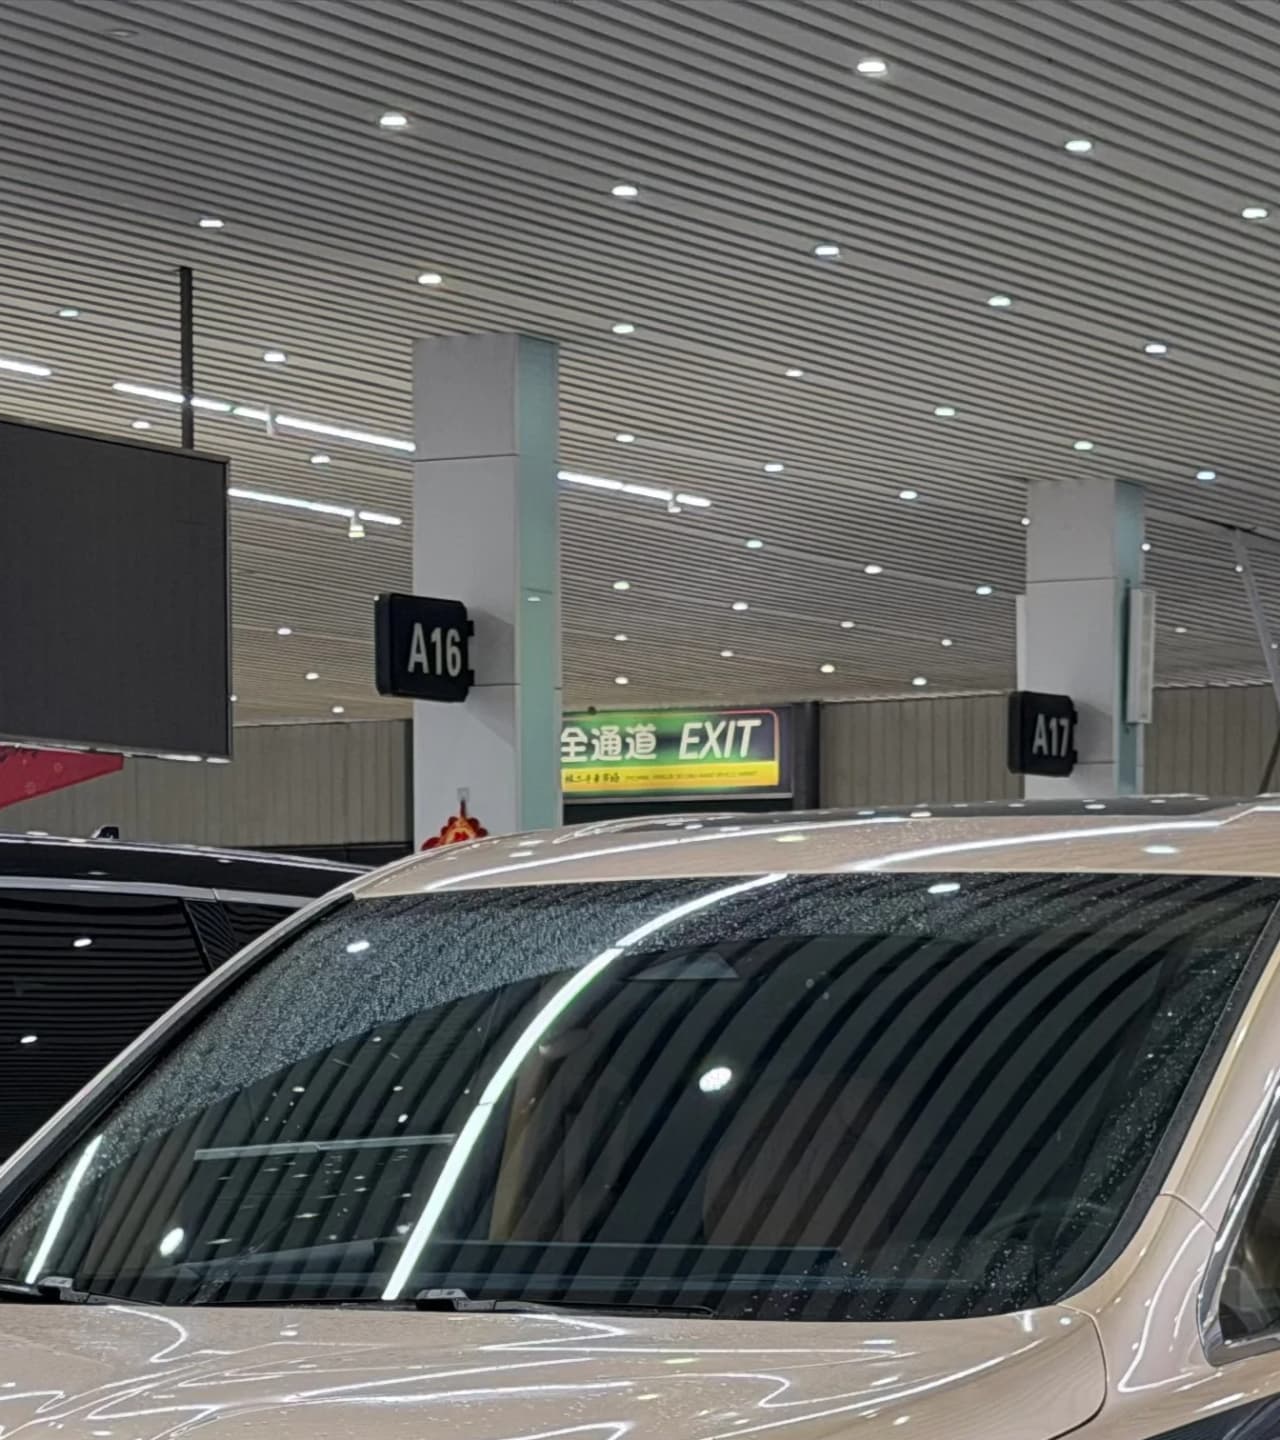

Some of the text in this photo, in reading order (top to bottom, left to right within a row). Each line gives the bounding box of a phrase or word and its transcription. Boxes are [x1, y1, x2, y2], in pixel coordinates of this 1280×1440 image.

[406, 622, 461, 678] A16
[678, 719, 762, 760] EXIT
[1031, 713, 1071, 758] A17
